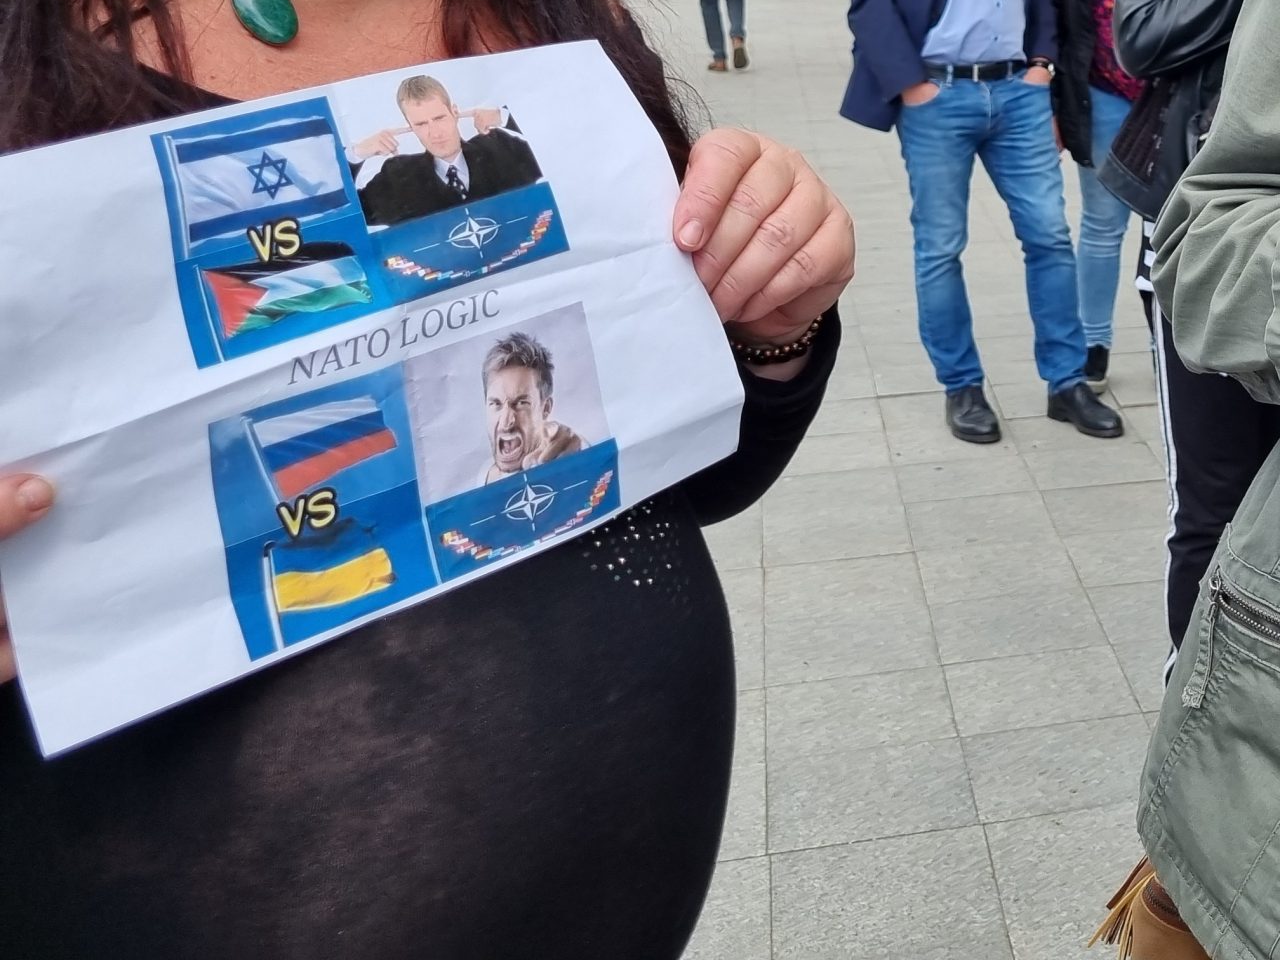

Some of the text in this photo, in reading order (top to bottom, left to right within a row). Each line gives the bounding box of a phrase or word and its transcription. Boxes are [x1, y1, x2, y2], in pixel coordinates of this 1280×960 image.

[247, 217, 302, 263] VS
[287, 289, 501, 386] NATO LOGIC
[278, 489, 337, 537] VS
